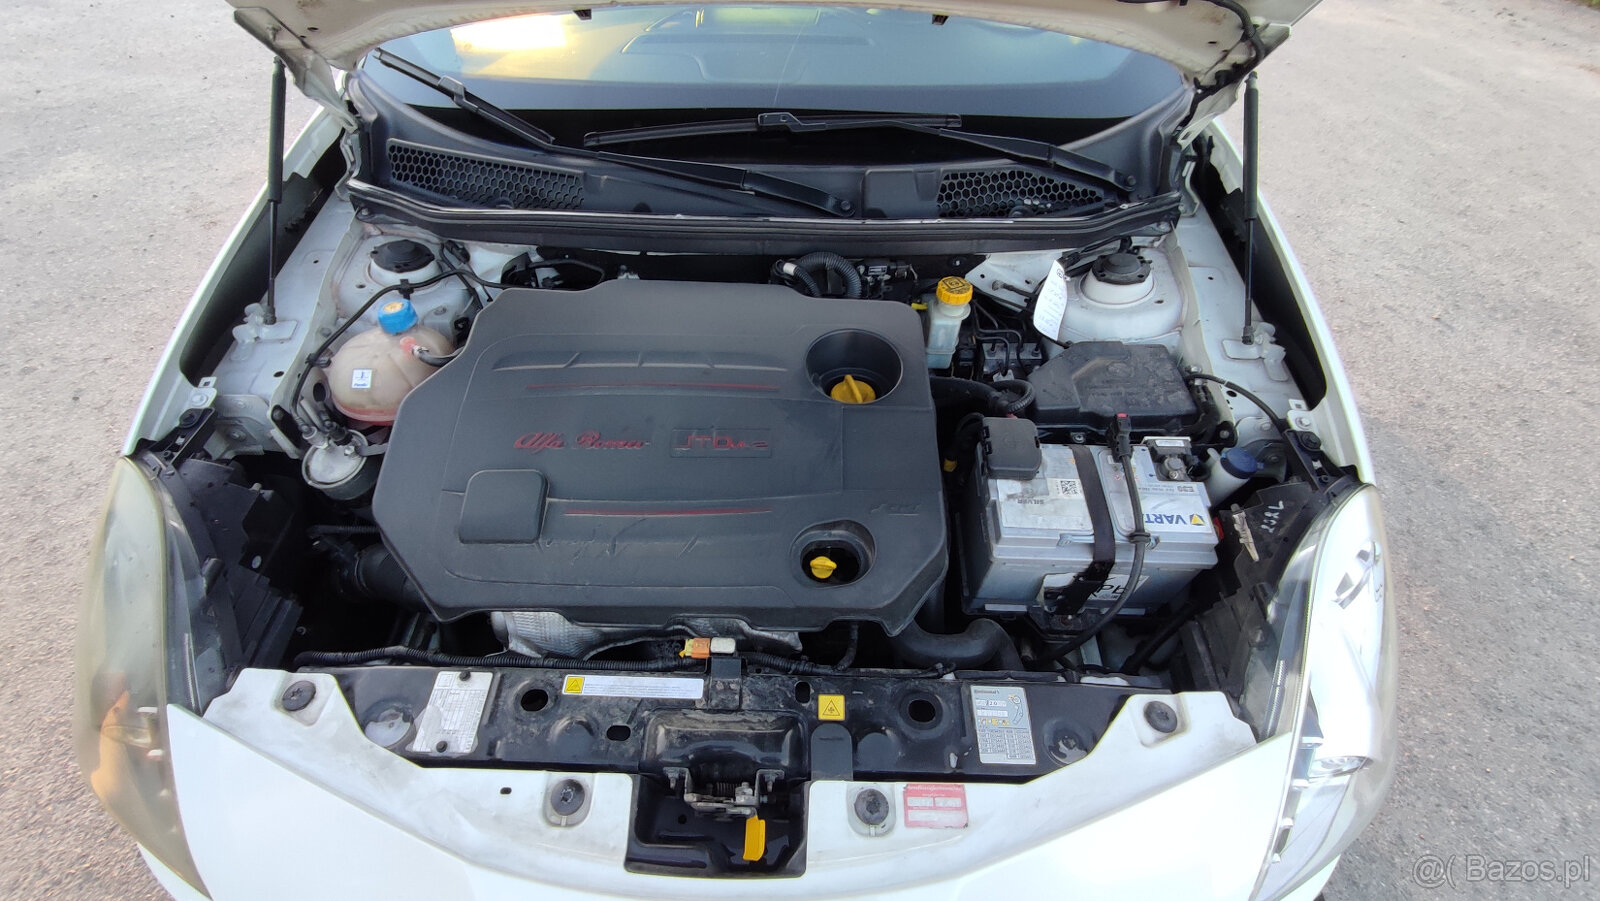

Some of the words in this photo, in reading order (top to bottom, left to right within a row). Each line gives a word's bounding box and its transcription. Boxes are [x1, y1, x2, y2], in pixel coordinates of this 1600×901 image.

[513, 432, 567, 455] Alfa
[576, 430, 646, 451] Romeo
[1141, 513, 1187, 525] VART
